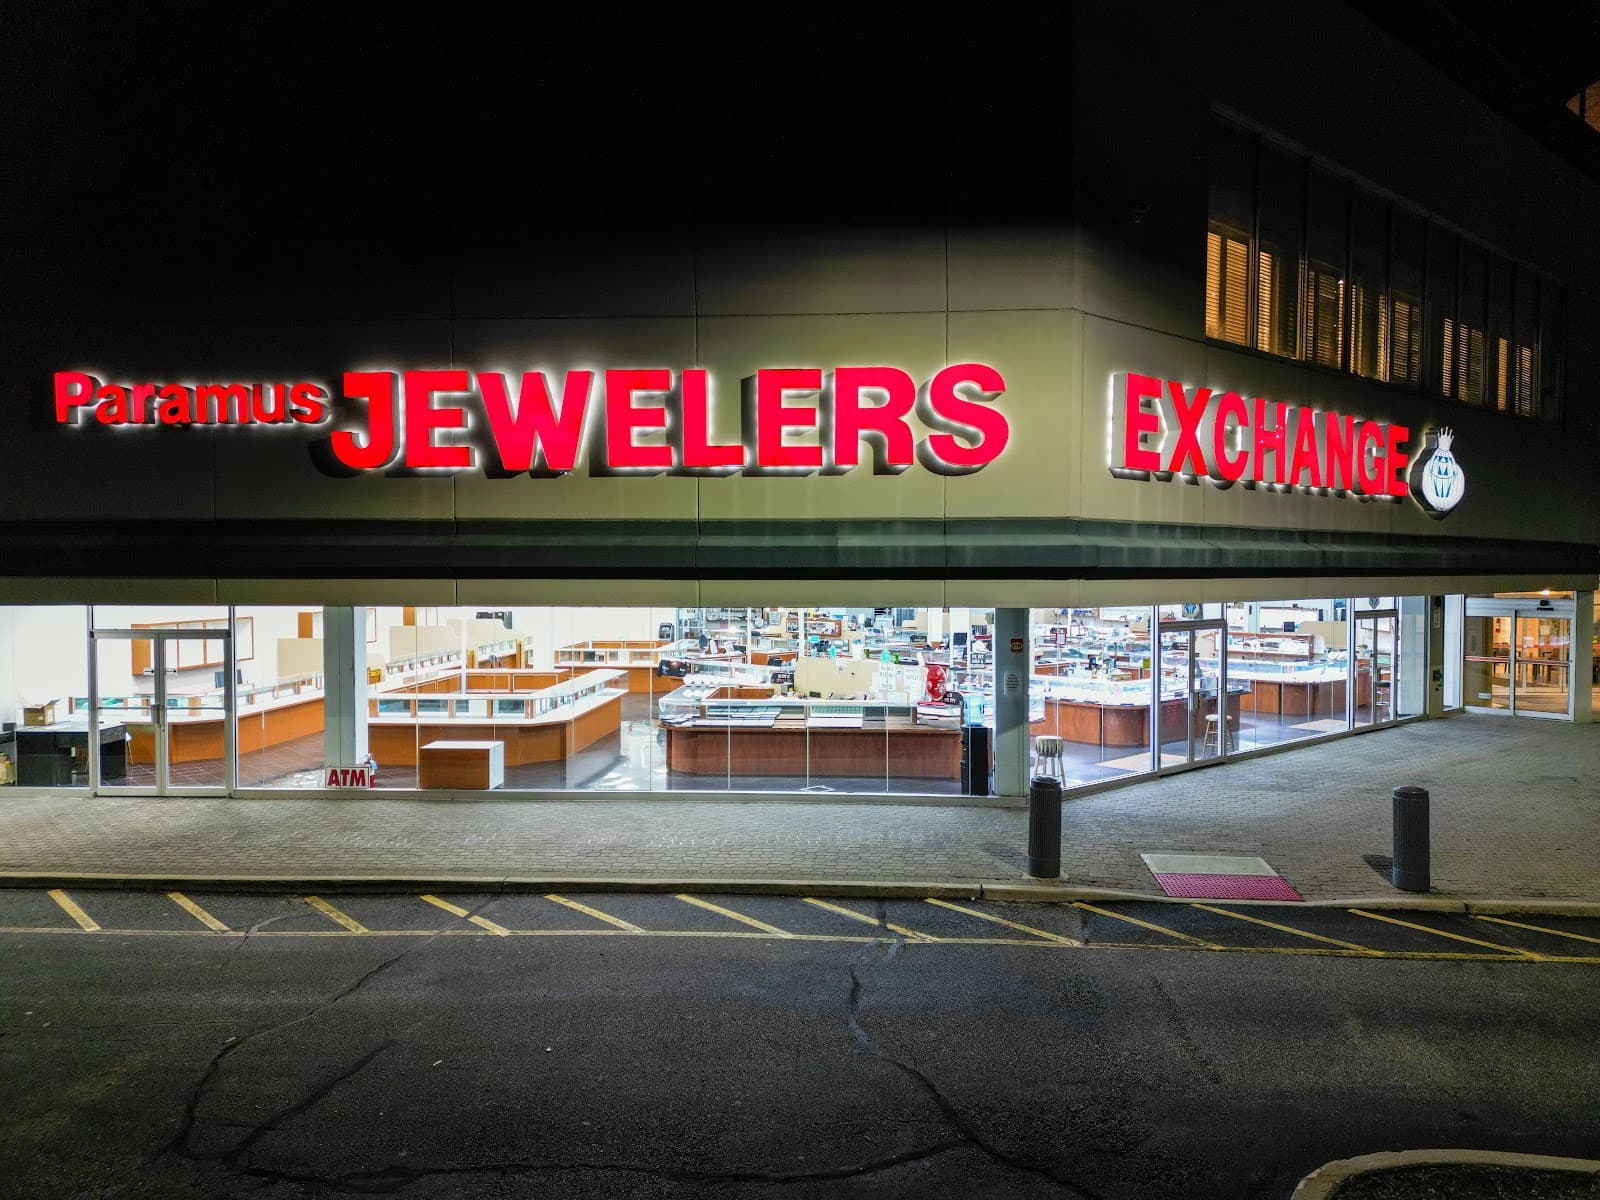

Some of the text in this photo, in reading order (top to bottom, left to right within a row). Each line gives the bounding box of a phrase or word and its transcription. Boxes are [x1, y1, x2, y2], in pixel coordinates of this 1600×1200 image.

[54, 363, 1010, 470] Paramus JEWELERS
[1124, 372, 1409, 497] EXCHANGE
[327, 768, 366, 787] ATM
